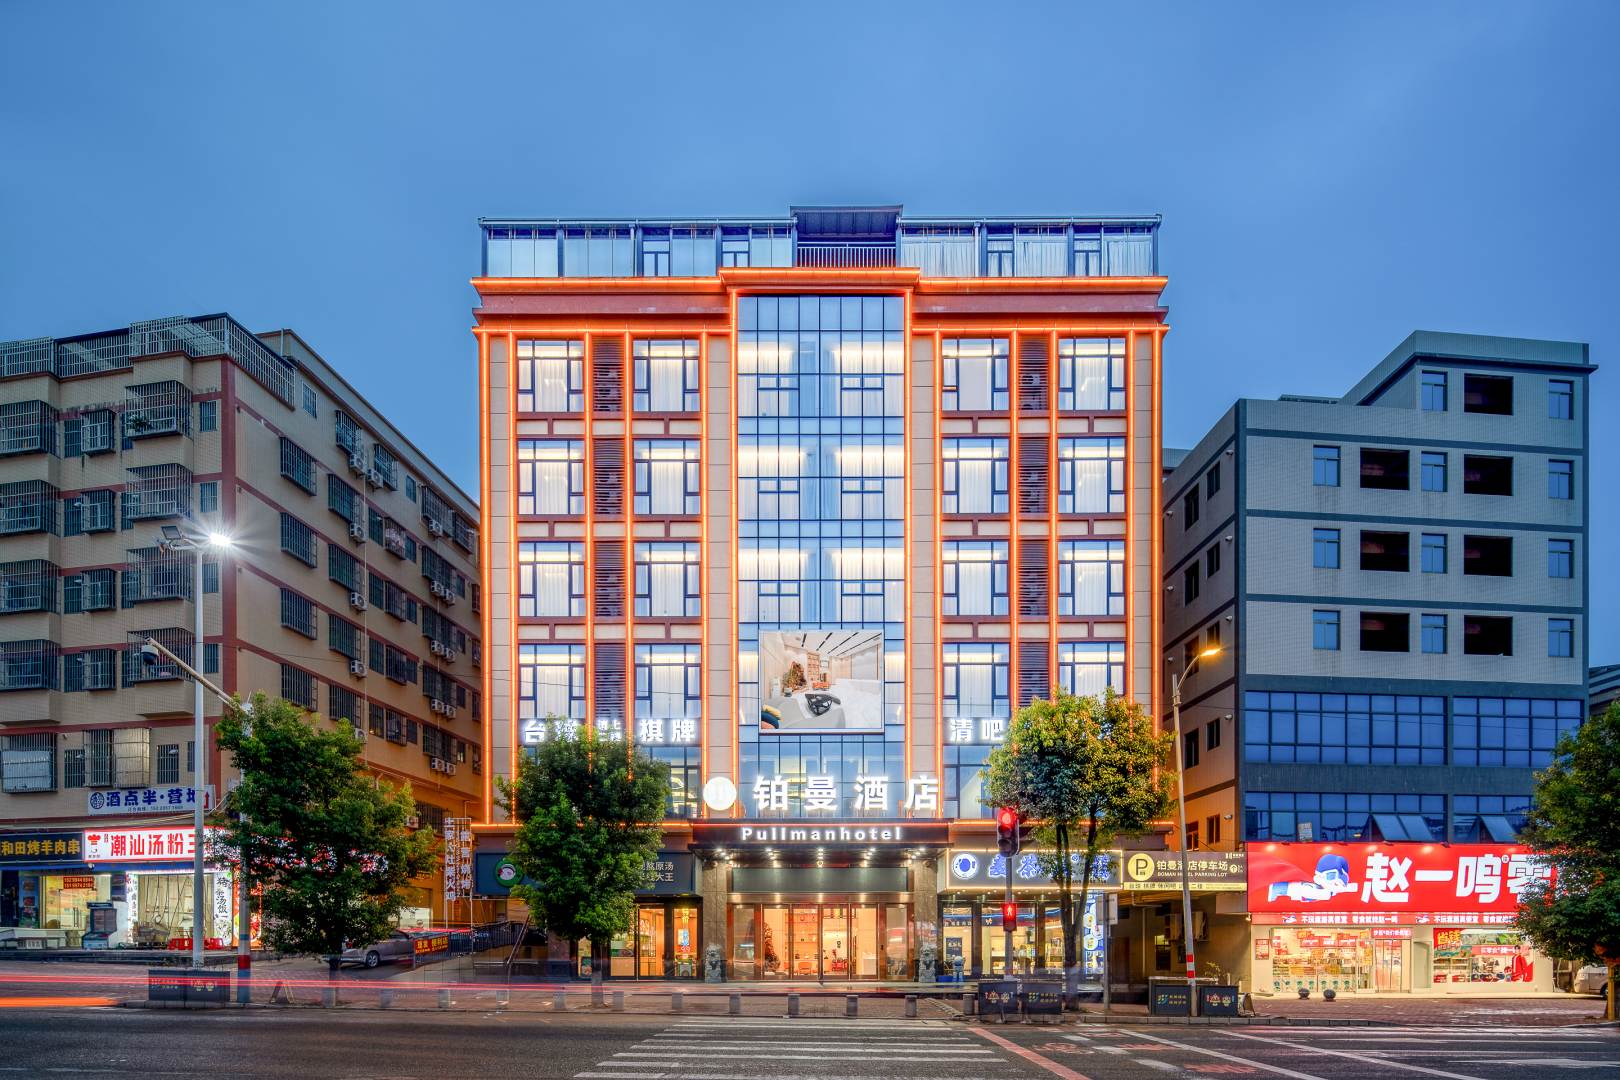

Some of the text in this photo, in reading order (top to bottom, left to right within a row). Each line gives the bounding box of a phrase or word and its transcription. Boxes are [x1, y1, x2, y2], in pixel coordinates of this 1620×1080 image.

[639, 718, 697, 743] 棋牌
[950, 718, 1004, 742] 清吧
[753, 775, 938, 811] 铂曼酒店
[741, 825, 902, 841] Pullmanhotel
[1, 838, 81, 856] 和田烤羊肉串
[1361, 852, 1556, 904] 赵一鸣零
